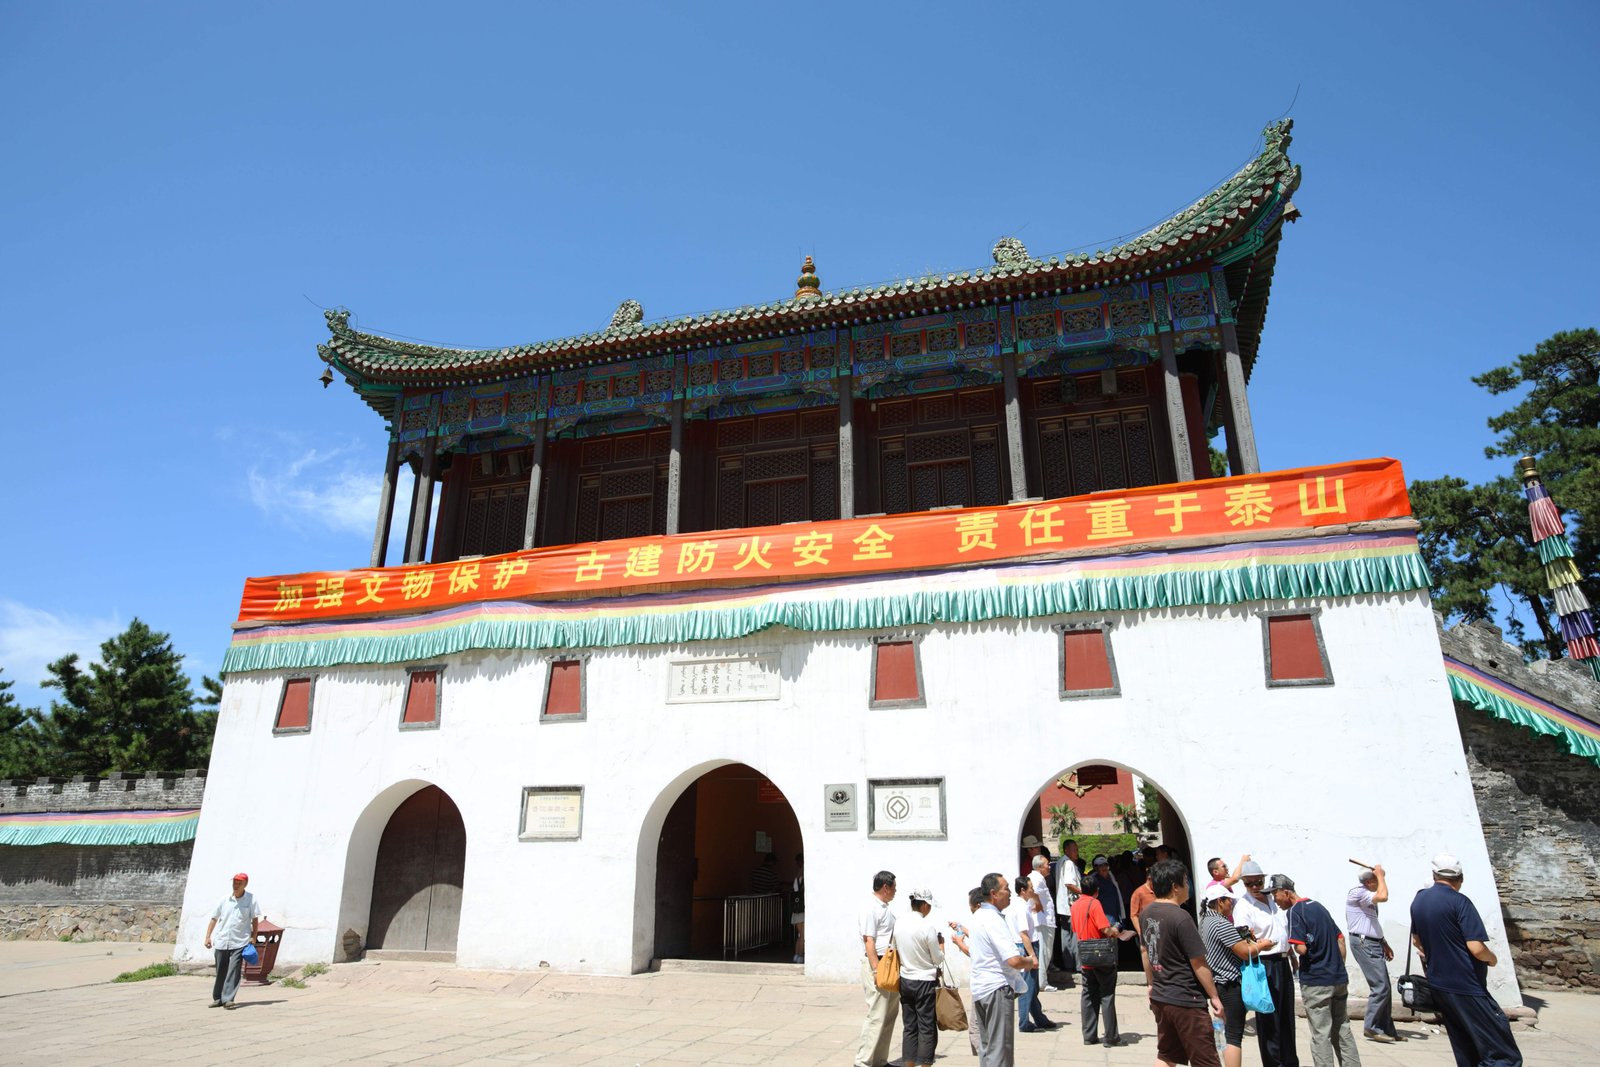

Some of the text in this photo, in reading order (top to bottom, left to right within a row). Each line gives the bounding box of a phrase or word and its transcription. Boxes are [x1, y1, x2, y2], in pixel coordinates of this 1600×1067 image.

[274, 476, 1348, 611] 加强文物保护 古建防火安全 责任重于泰山
